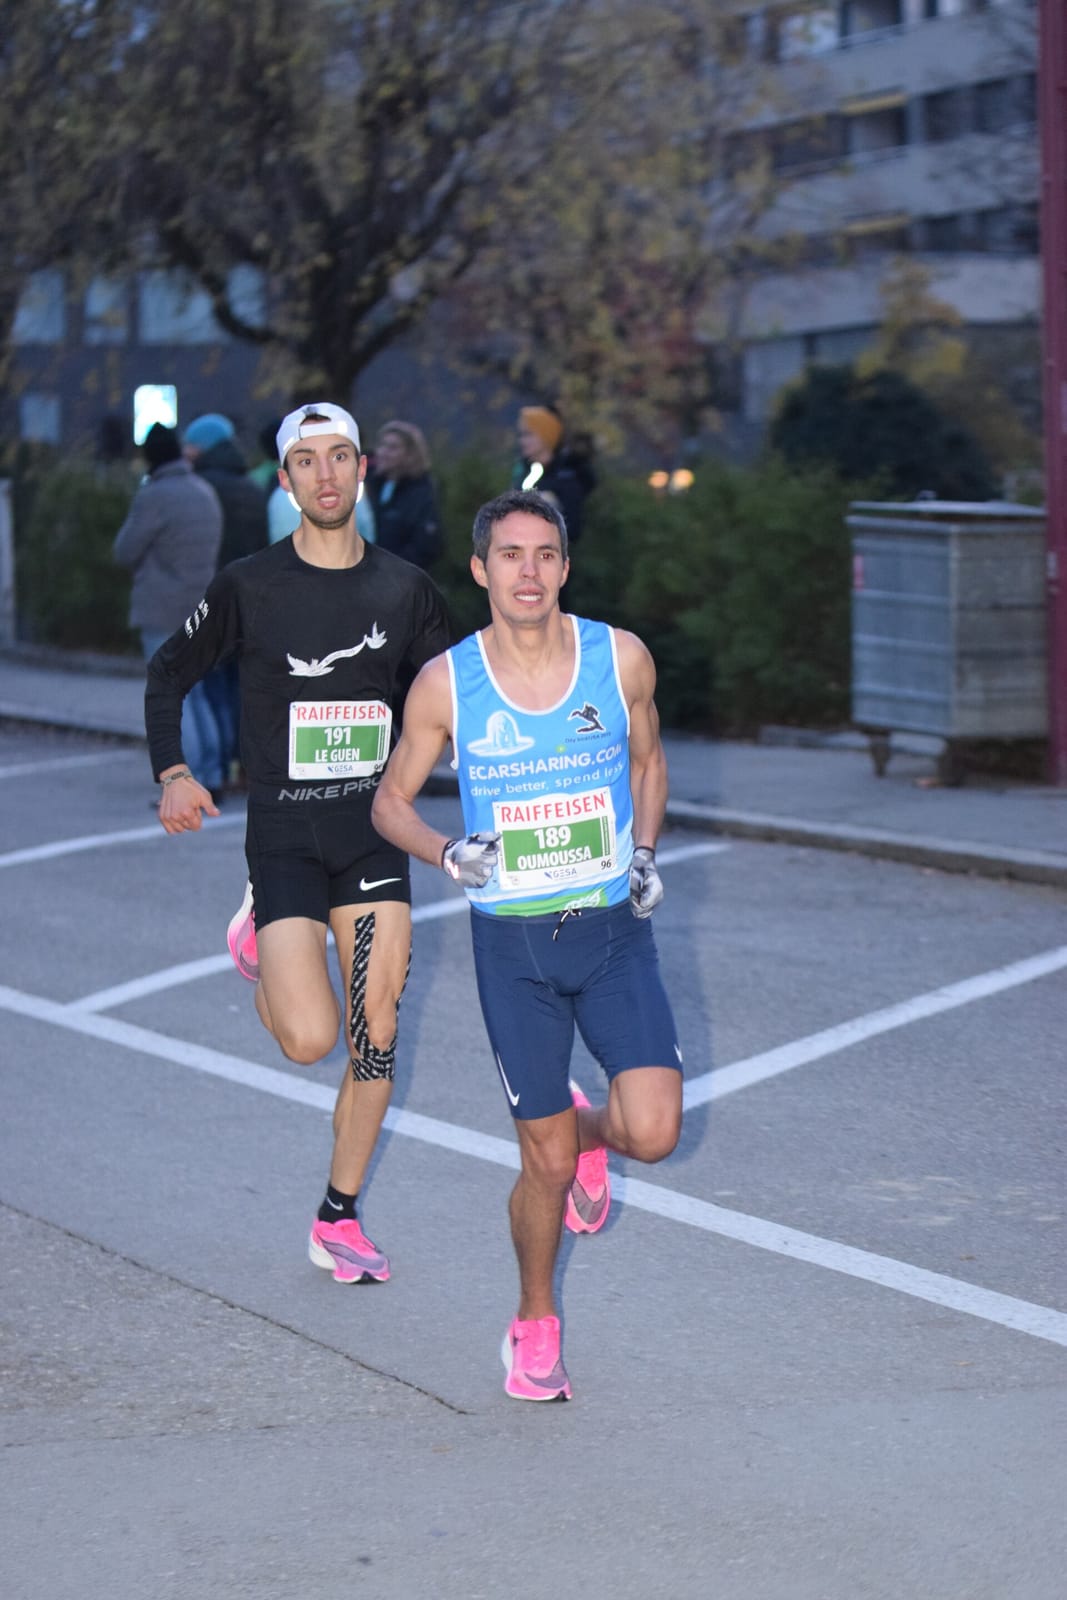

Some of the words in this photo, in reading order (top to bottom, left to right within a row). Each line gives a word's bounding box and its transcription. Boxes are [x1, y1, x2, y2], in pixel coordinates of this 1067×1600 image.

[296, 705, 387, 721] RAIFFEISEN
[324, 726, 351, 746] 191
[314, 749, 328, 762] LE
[330, 748, 360, 762] GUEN
[278, 784, 341, 801] NIKE
[470, 786, 501, 797] drive
[555, 769, 600, 788] spend
[501, 792, 606, 823] RAIFFEISEN
[534, 825, 572, 849] 189
[517, 845, 592, 870] OUMOUSSA
[600, 859, 612, 870] 96
